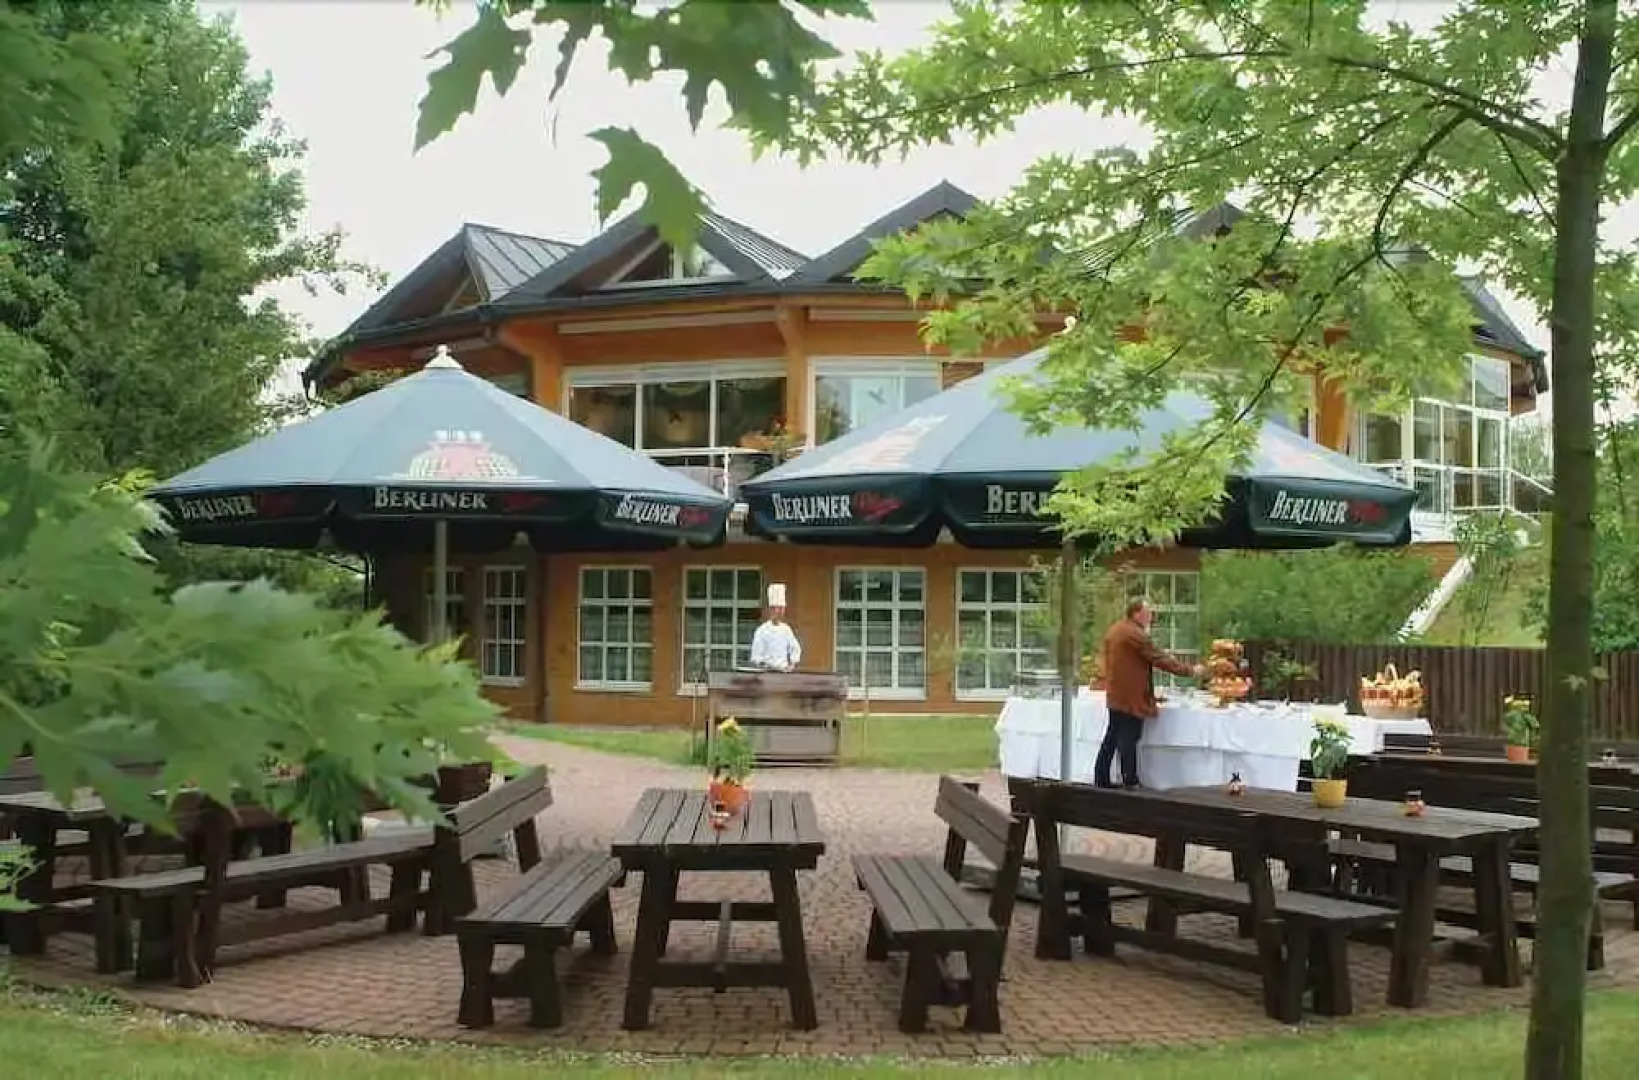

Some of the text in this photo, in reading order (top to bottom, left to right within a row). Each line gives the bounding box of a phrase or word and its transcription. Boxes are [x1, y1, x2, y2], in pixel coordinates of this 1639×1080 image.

[374, 486, 488, 511] BERLINER
[615, 494, 680, 525] BERLINER
[772, 492, 853, 523] BERLINER
[1269, 490, 1348, 525] BERLINER
